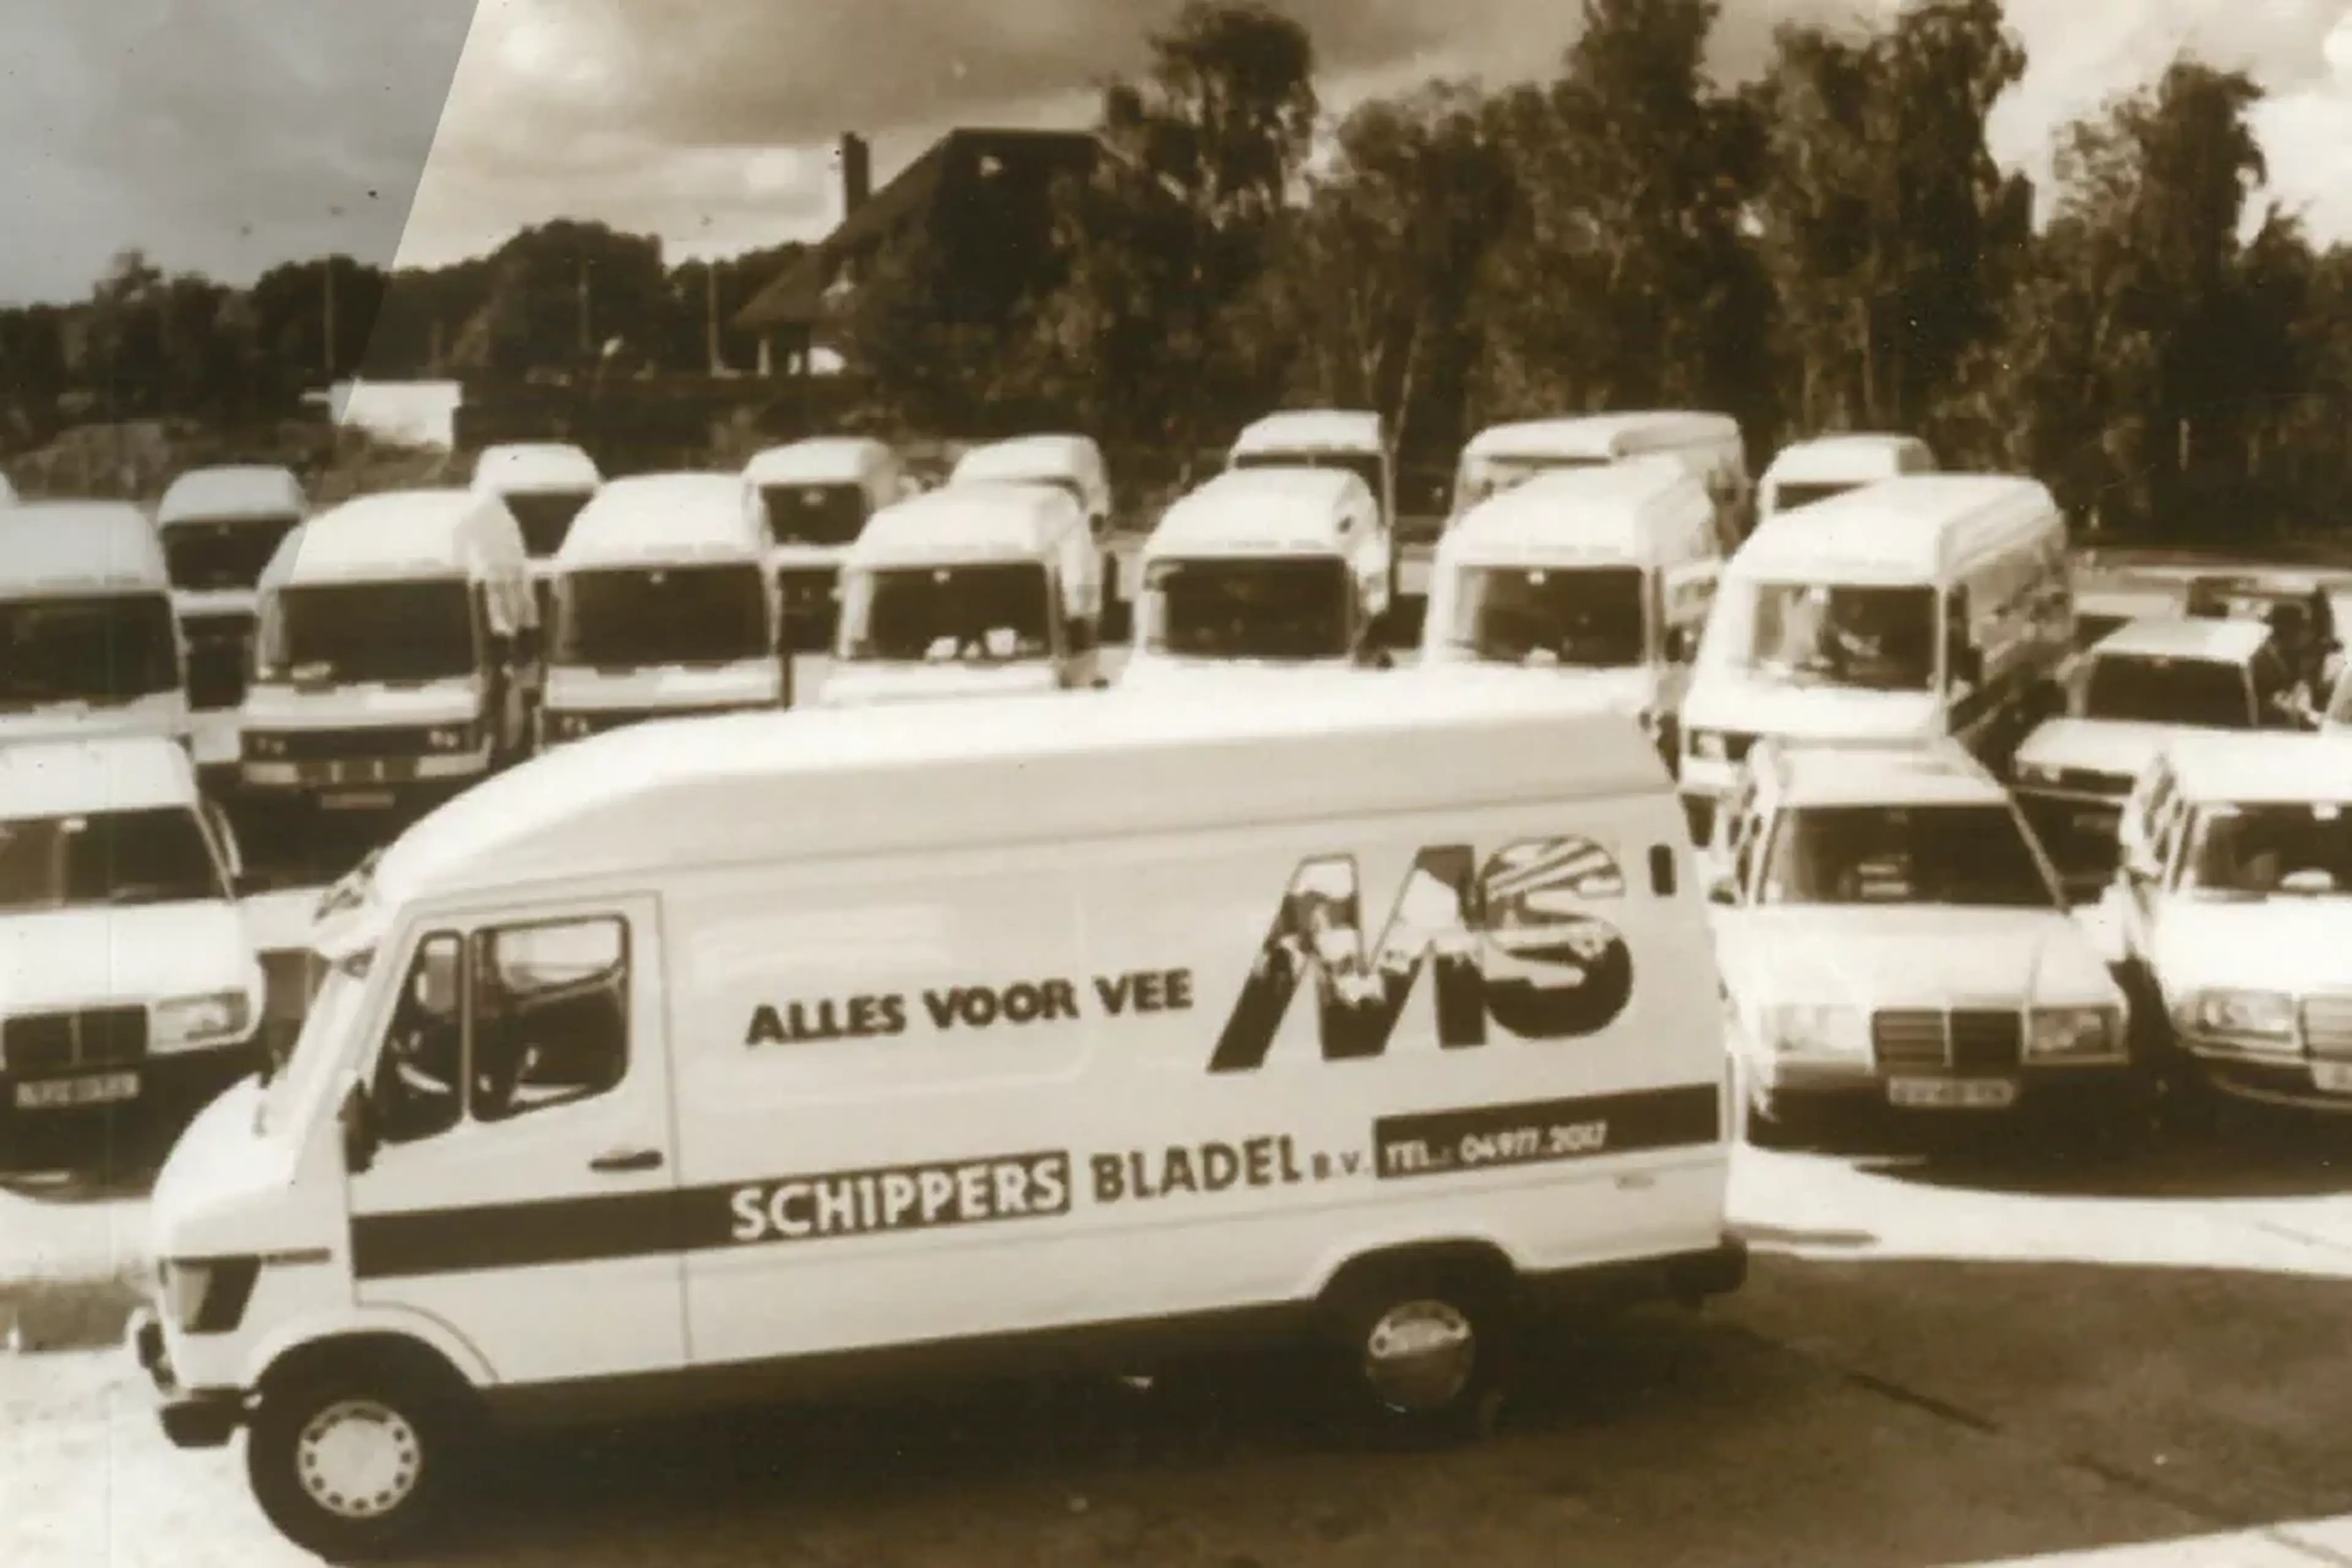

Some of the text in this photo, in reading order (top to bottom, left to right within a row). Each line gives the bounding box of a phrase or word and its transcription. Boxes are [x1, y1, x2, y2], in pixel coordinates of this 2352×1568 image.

[744, 968, 1193, 1046] ALLES VOOR VEE
[1205, 835, 1634, 1076] MS
[730, 1158, 1065, 1241] SCHIPPERS
[1088, 1133, 1303, 1203] BLADEL
